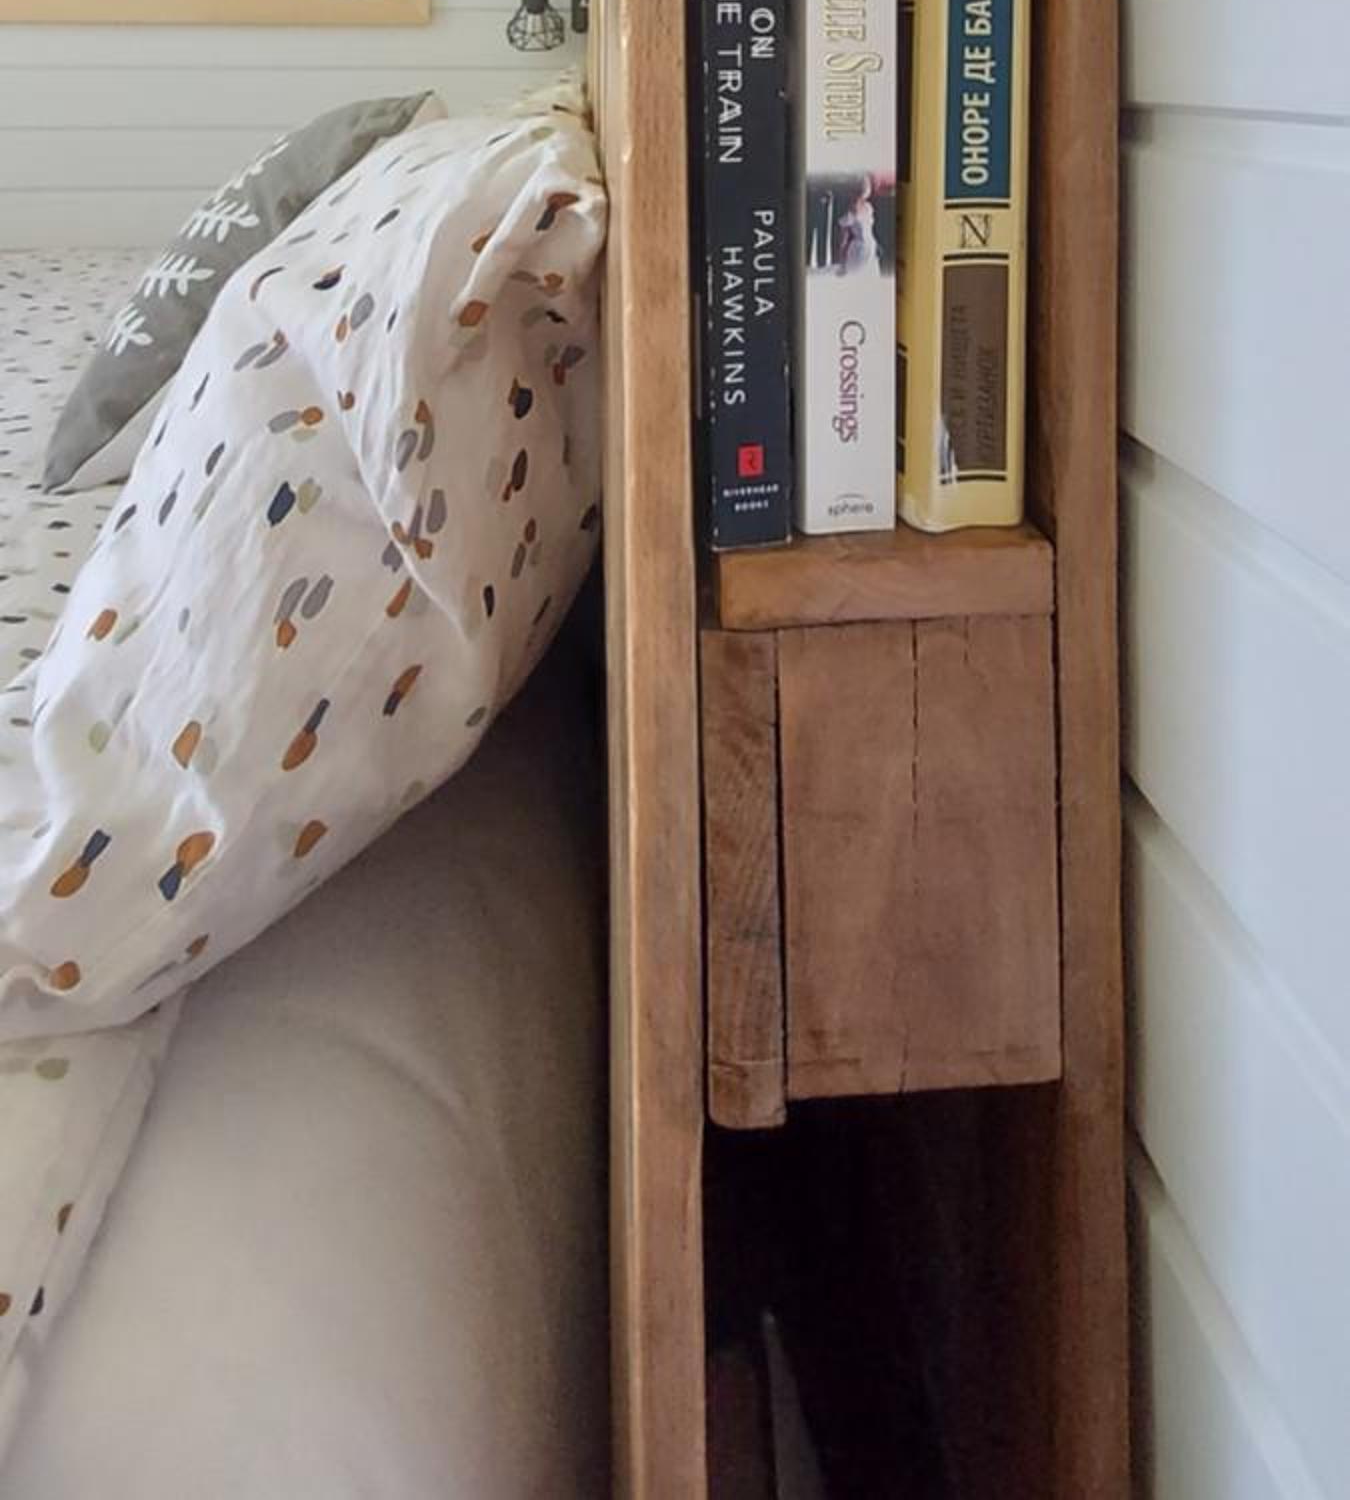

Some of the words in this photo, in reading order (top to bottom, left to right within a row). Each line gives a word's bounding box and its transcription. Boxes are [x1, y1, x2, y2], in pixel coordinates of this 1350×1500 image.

[749, 7, 775, 60] ON
[962, 45, 996, 84] ДЕ
[717, 43, 743, 164] TRAIN
[961, 92, 991, 186] ОНОРЕ
[752, 208, 776, 317] PAULA
[722, 246, 747, 406] HAWKINS
[831, 320, 866, 443] Crossings
[828, 500, 875, 516] sphere
